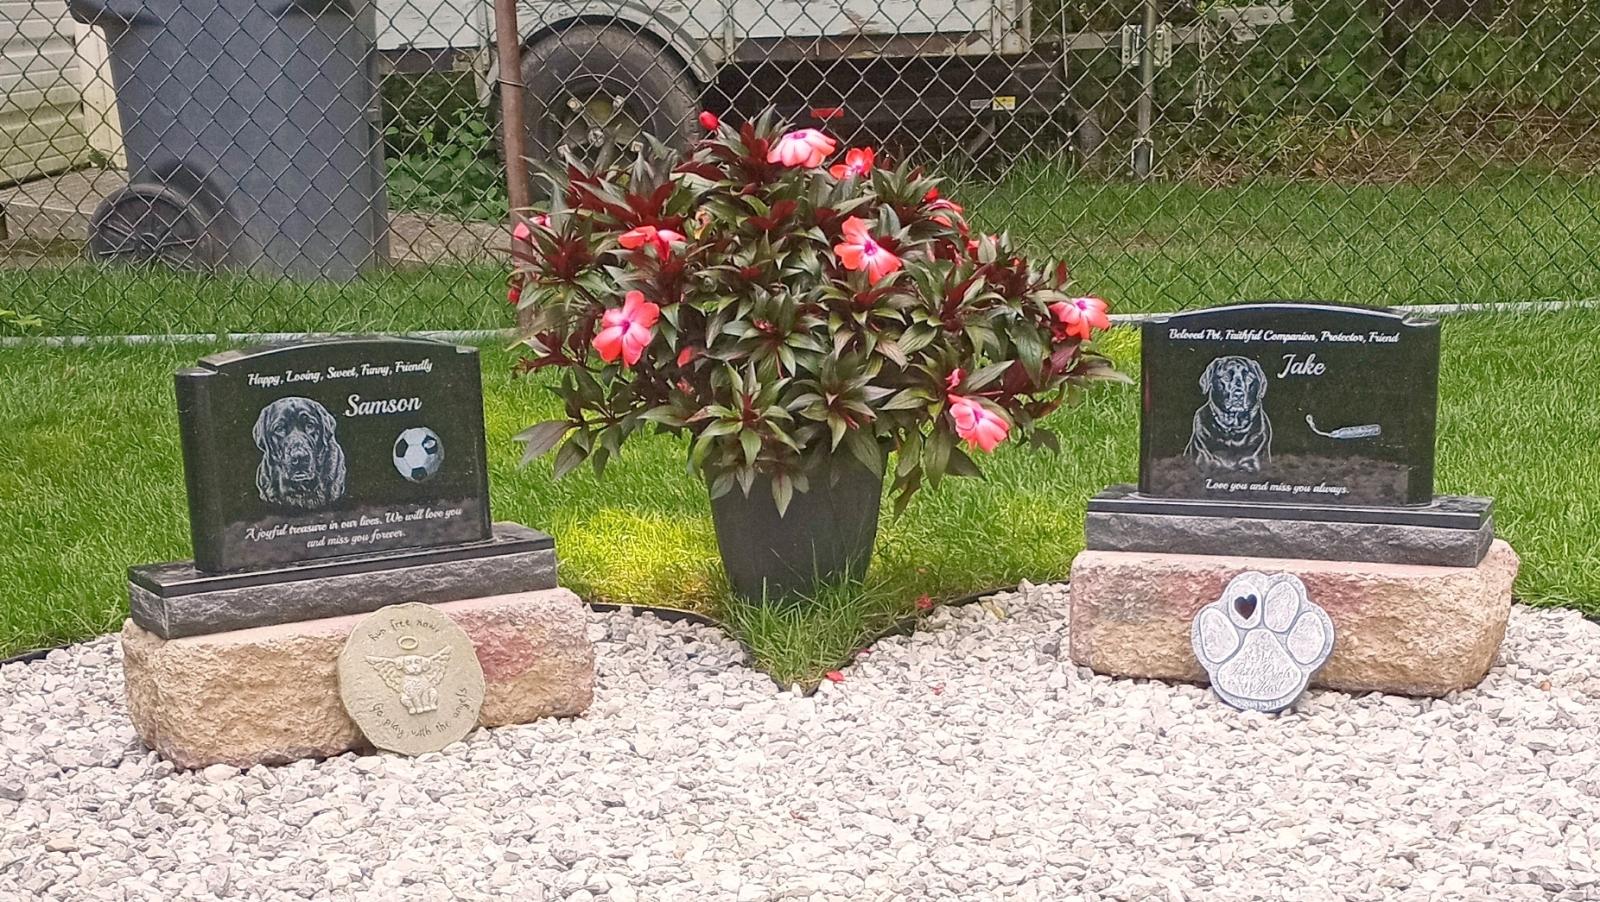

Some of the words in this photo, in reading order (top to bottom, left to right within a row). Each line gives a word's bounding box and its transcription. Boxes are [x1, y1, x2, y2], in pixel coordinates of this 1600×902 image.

[1168, 328, 1204, 340] Beloved
[1206, 329, 1223, 341] Pet,
[1225, 329, 1262, 343] Faithful
[1263, 330, 1318, 343] Companion,
[1320, 331, 1366, 344] Protector,
[1368, 331, 1400, 343] Friend
[247, 373, 283, 388] Happy,
[285, 370, 324, 383] Loving,
[327, 366, 359, 379] Sweet,
[360, 363, 392, 376] Funny,
[394, 358, 432, 373] Friendly
[1277, 353, 1326, 379] Jake
[343, 394, 422, 417] Samson
[1205, 478, 1228, 489] Love
[1230, 482, 1248, 492] you
[1249, 481, 1268, 491] and
[1270, 482, 1292, 492] miss
[1292, 484, 1311, 494] you
[1313, 482, 1350, 496] always.
[244, 528, 255, 540] A
[254, 528, 287, 541] joyful
[288, 523, 327, 535] treasure
[329, 520, 339, 530] in
[341, 519, 357, 529] our
[359, 515, 383, 526] lives.
[384, 511, 403, 523] We
[405, 509, 424, 521] will
[425, 507, 443, 519] love
[444, 507, 463, 519] you
[306, 535, 326, 548] and
[327, 533, 349, 545] miss
[351, 533, 369, 545] you
[369, 529, 406, 545] forever.
[367, 628, 386, 642] Run
[390, 619, 411, 632] free
[372, 702, 384, 717] Go
[383, 719, 404, 738] play
[411, 725, 432, 737] with
[435, 721, 449, 734] the
